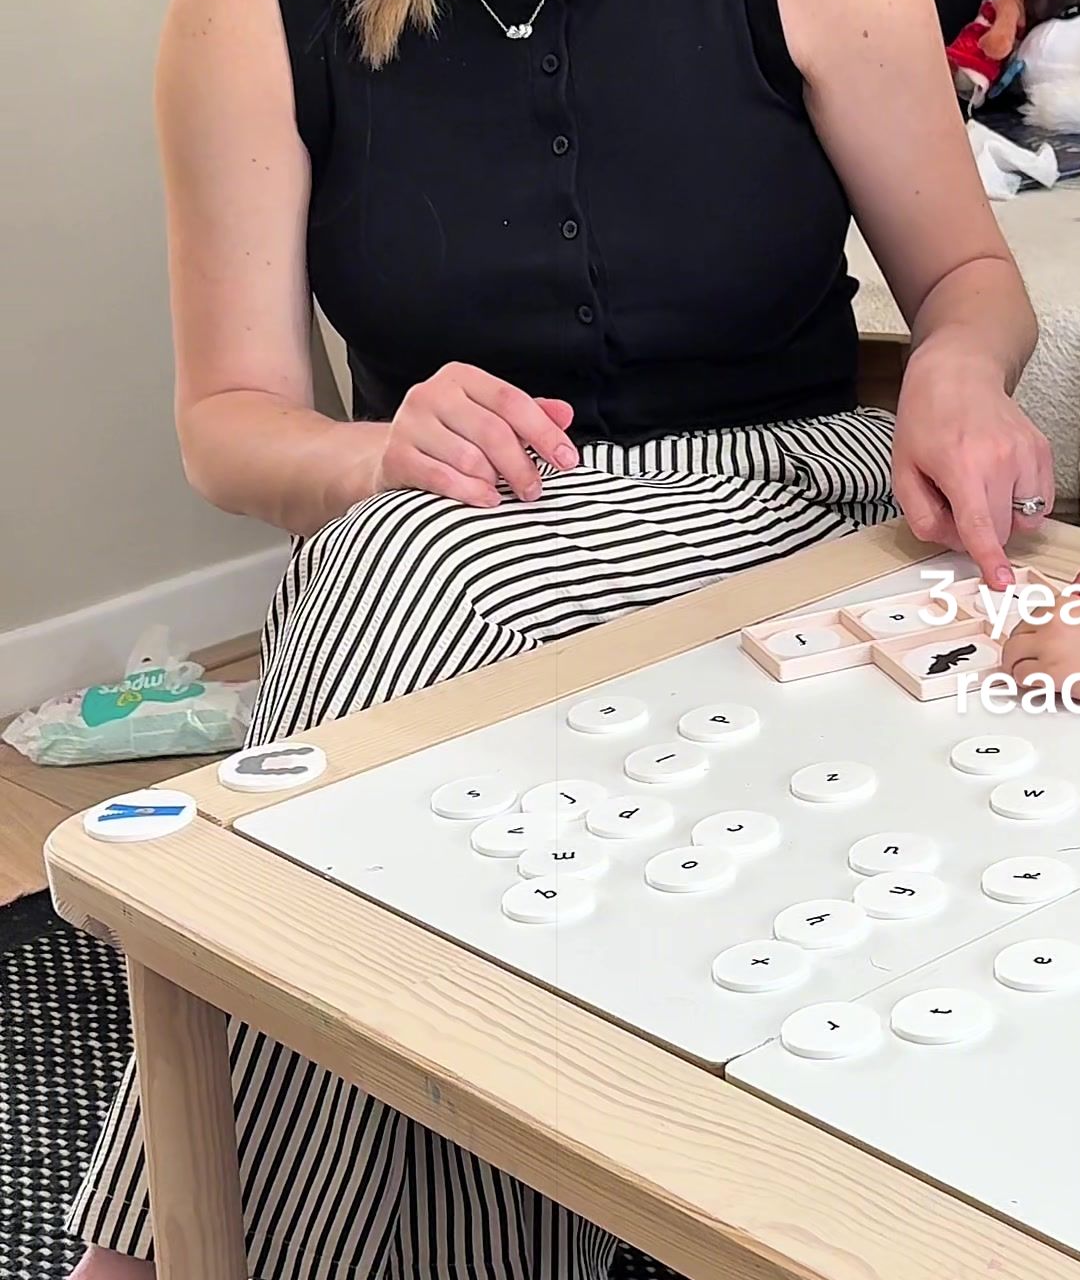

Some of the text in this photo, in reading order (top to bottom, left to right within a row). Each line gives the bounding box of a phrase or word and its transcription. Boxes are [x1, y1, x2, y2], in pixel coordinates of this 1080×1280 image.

[680, 860, 699, 870] o
[1012, 872, 1041, 880] k
[889, 886, 916, 897] y
[805, 913, 831, 926] h
[750, 957, 770, 966] x
[1033, 956, 1052, 965] e
